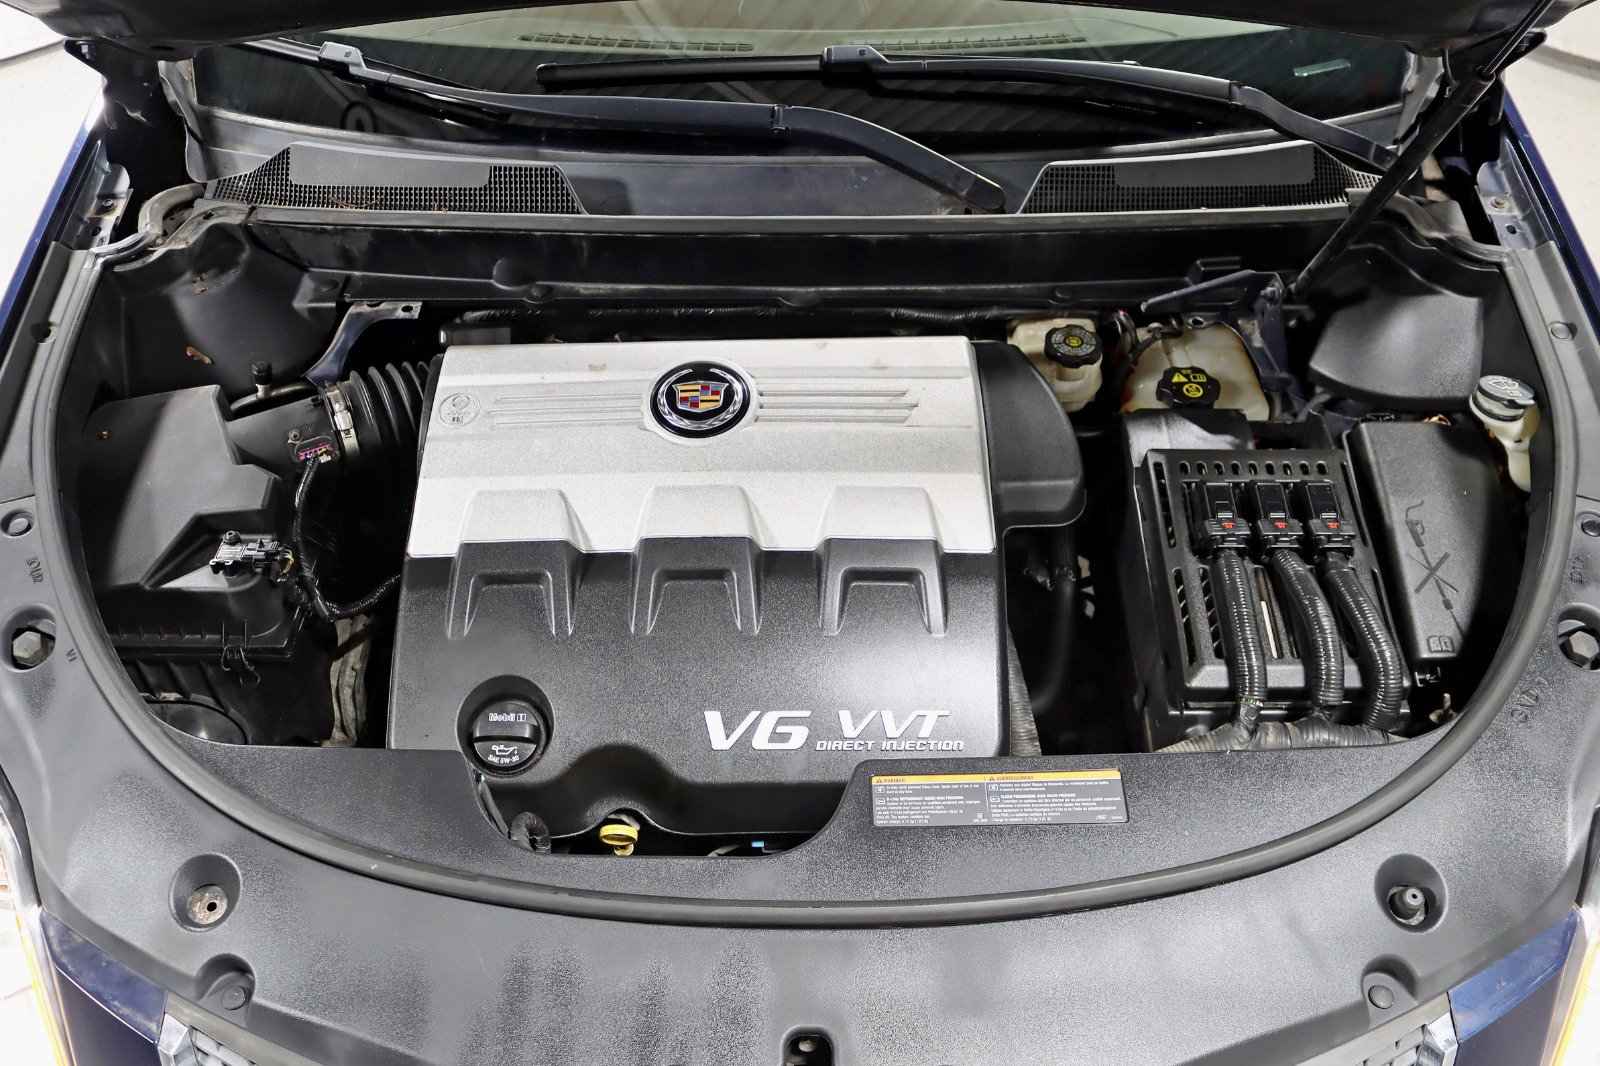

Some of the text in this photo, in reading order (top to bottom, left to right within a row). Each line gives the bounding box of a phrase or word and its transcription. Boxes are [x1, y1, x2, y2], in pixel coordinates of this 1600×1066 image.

[488, 712, 516, 722] Mobil
[704, 710, 950, 750] V6 VVT
[815, 740, 964, 751] DIRECT INJECTION
[487, 754, 520, 764] SAE 5W-30
